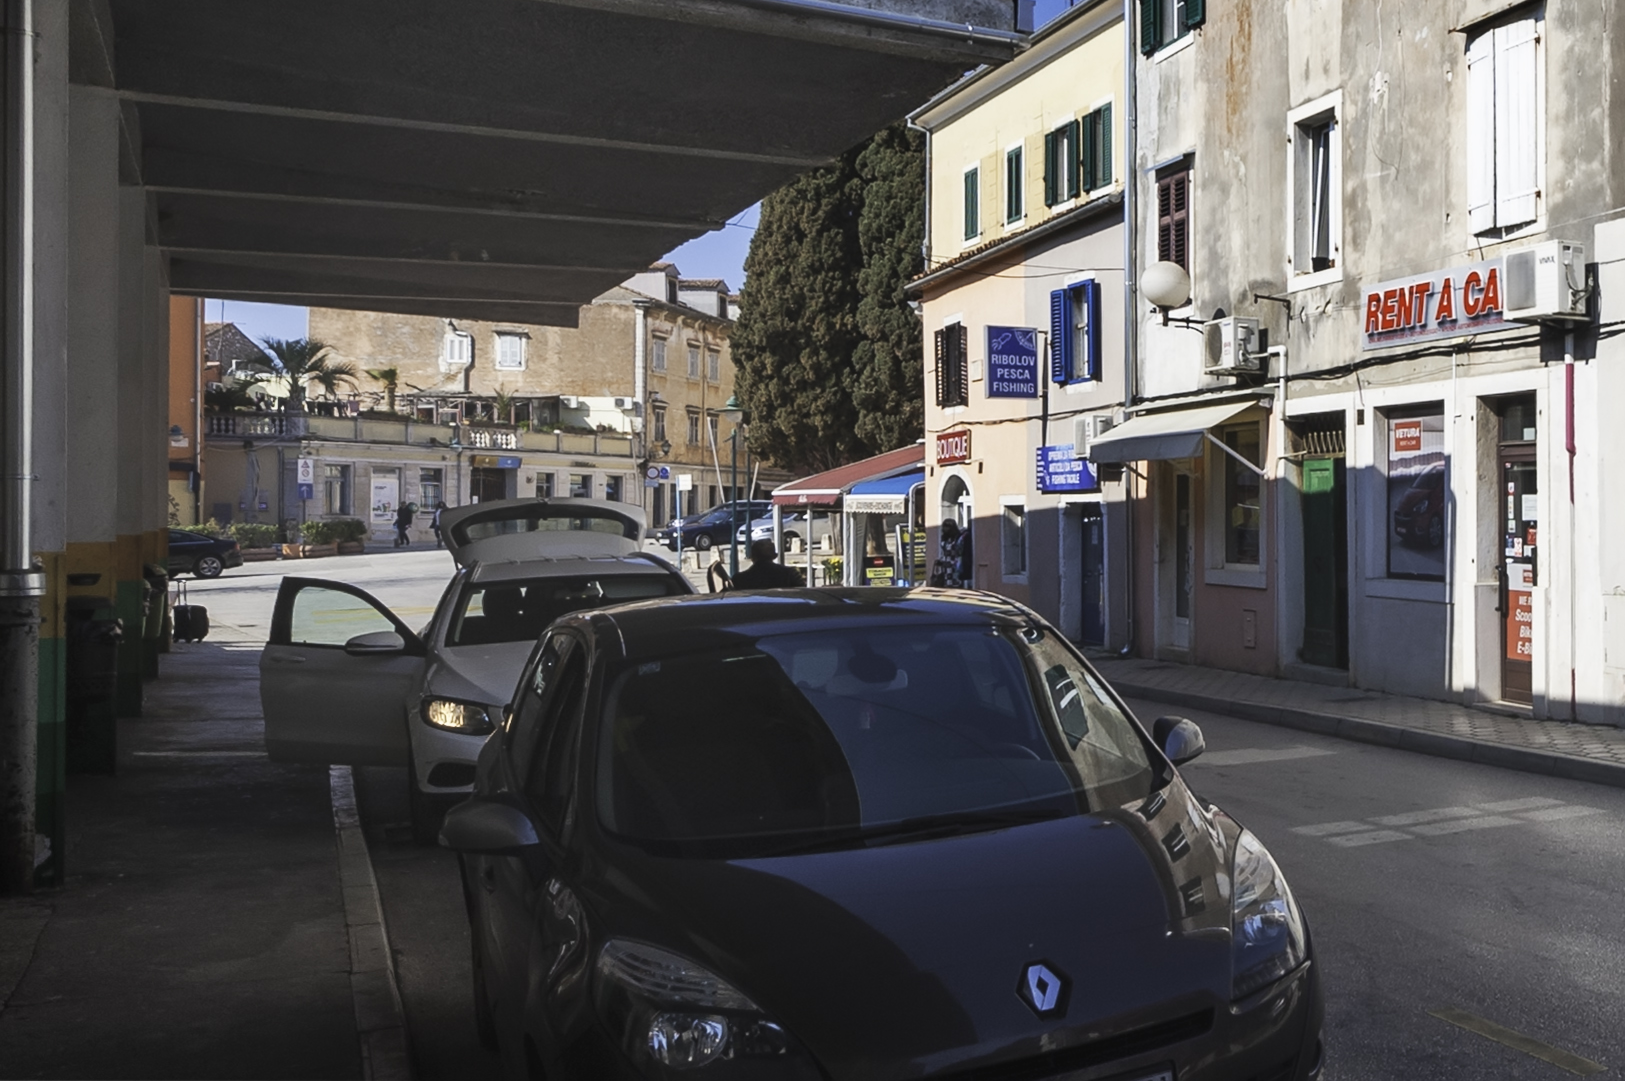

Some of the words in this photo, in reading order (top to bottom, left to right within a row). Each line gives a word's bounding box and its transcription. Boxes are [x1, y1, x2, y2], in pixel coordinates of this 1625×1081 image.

[1364, 280, 1433, 334] RENT
[1435, 277, 1455, 321] A
[1463, 267, 1504, 317] CA
[991, 354, 1035, 366] RIBOLOV
[997, 368, 1030, 379] PESCA
[993, 381, 1035, 393] FISHING
[937, 435, 967, 459] BOUTIQUE
